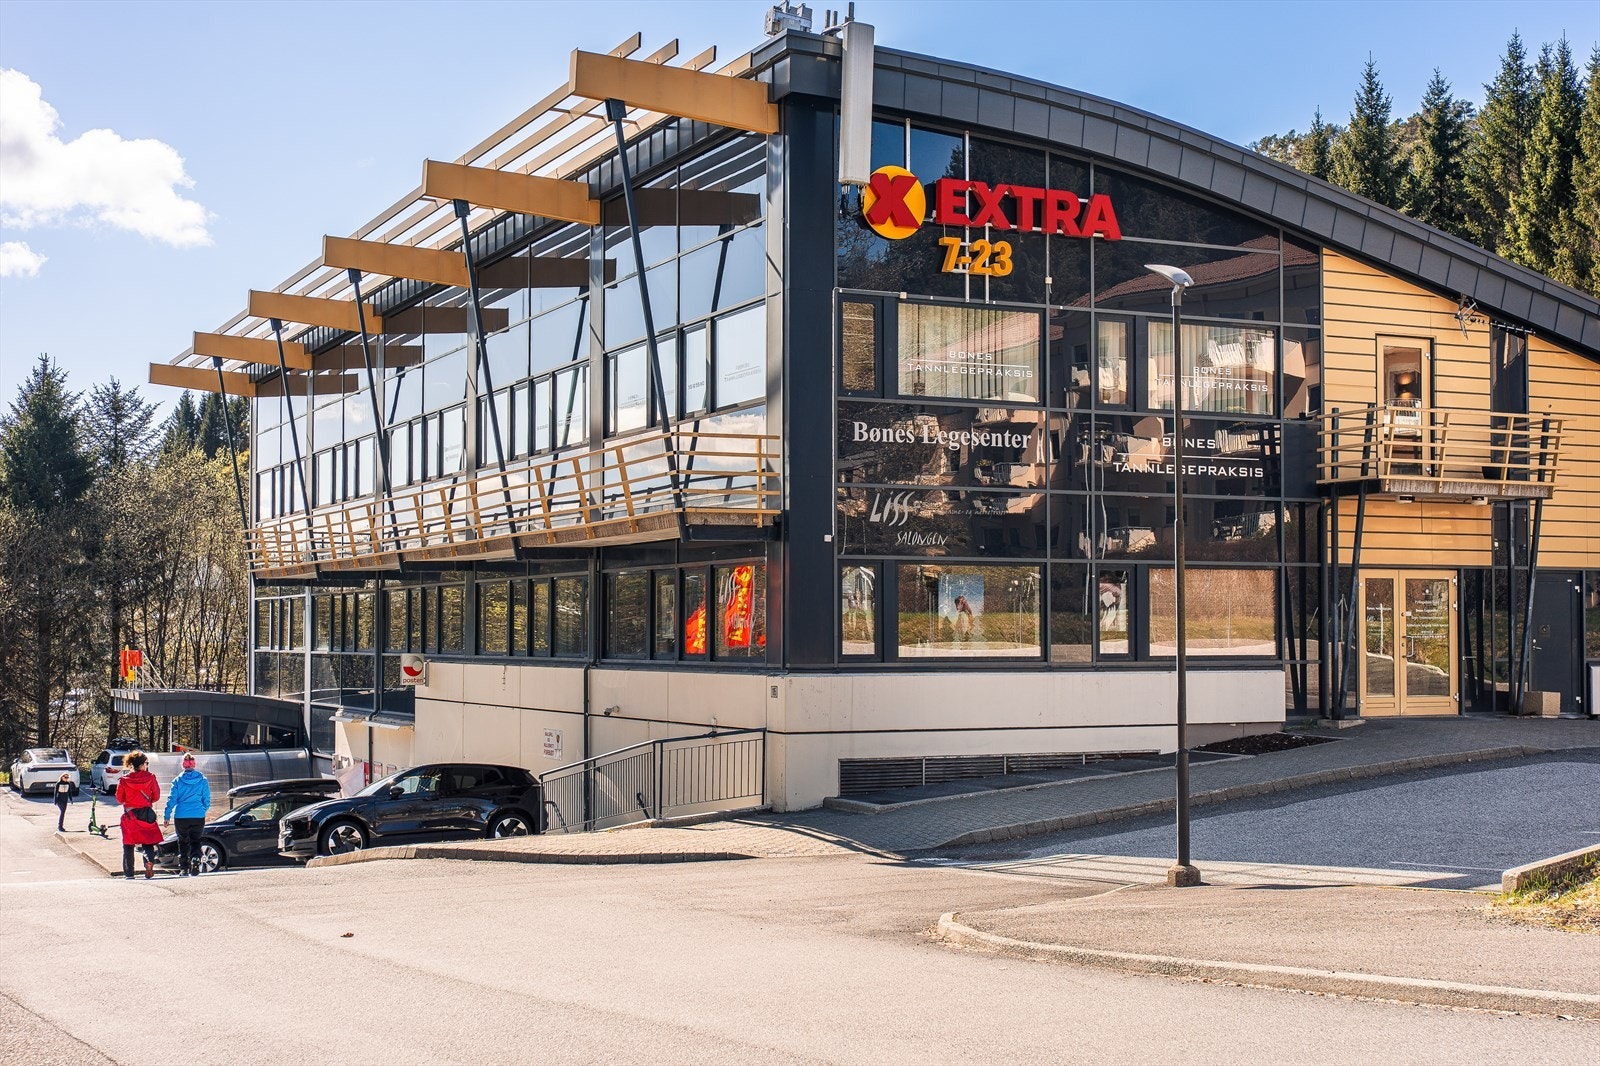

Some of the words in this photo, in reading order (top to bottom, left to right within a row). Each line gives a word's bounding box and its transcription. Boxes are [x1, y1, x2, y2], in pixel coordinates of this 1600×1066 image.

[936, 177, 1122, 241] EXTRA
[939, 236, 1013, 277] 7-23
[908, 363, 1033, 378] TANNLEGEPRAKSIS
[852, 421, 915, 443] Bønes
[922, 425, 1032, 451] Legesenter
[1162, 437, 1216, 449] BNES
